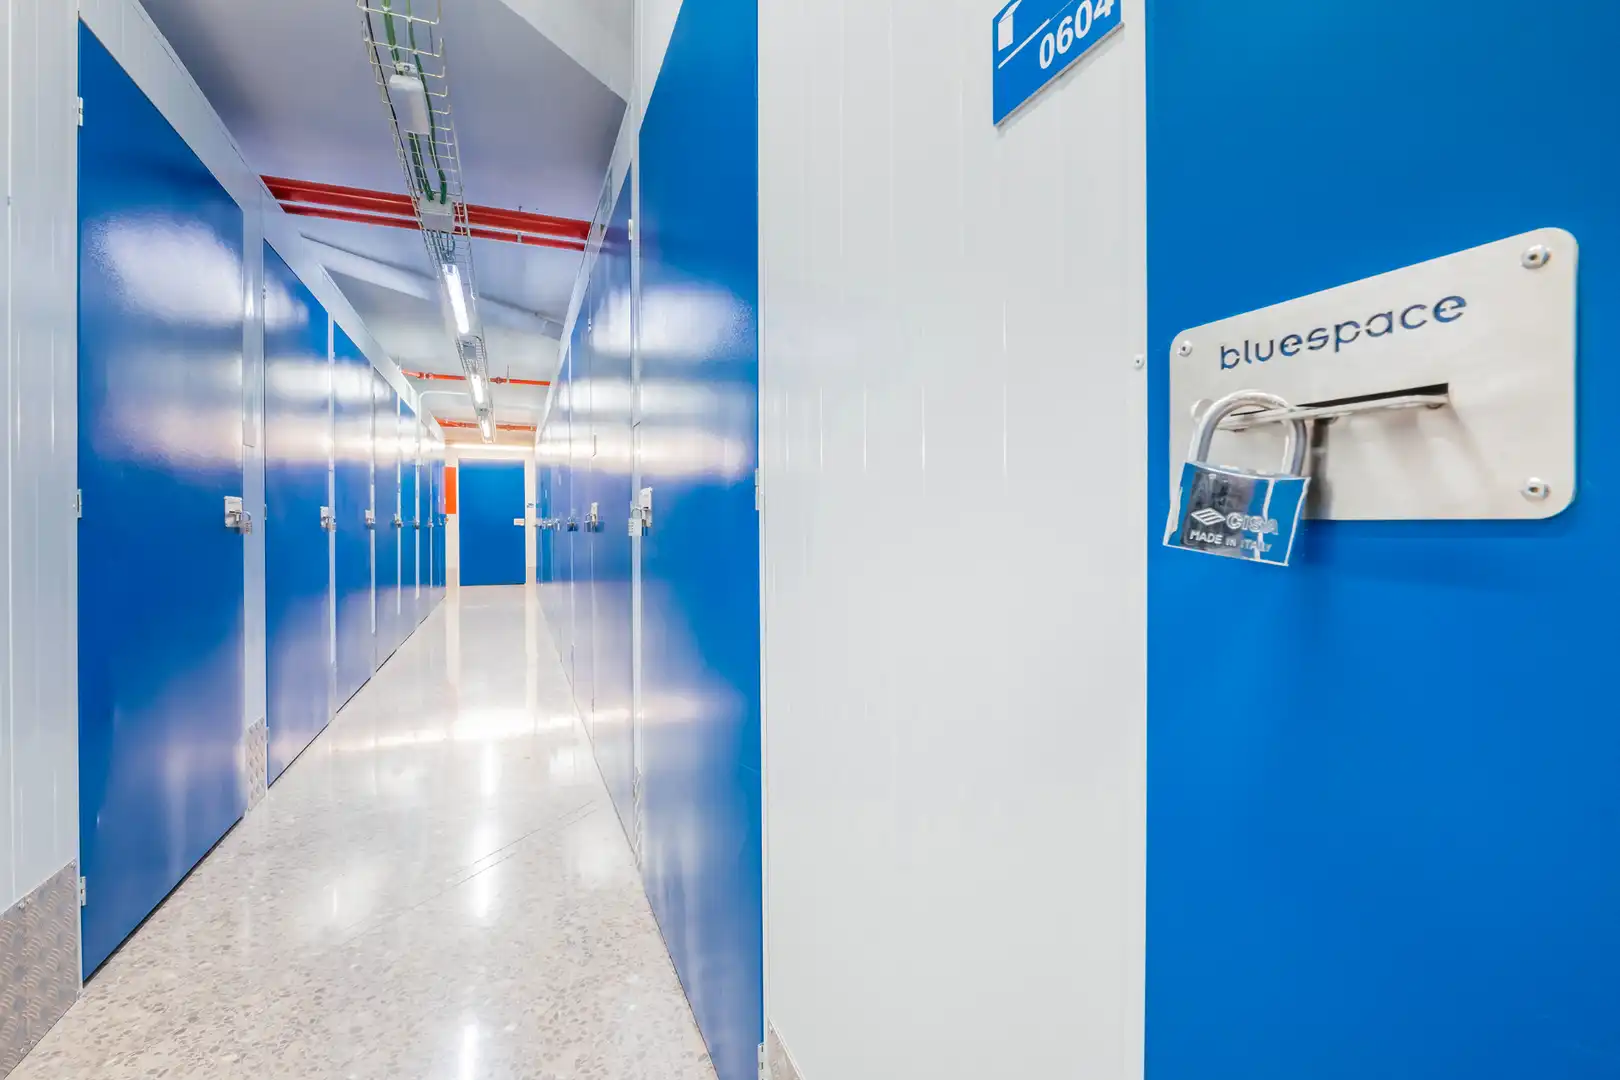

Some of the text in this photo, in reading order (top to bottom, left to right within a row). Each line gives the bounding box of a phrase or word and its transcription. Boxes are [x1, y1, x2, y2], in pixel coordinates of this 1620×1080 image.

[1220, 295, 1467, 370] bluespace
[1226, 512, 1279, 535] CISA
[1189, 529, 1224, 545] MADE
[1225, 537, 1237, 547] IN
